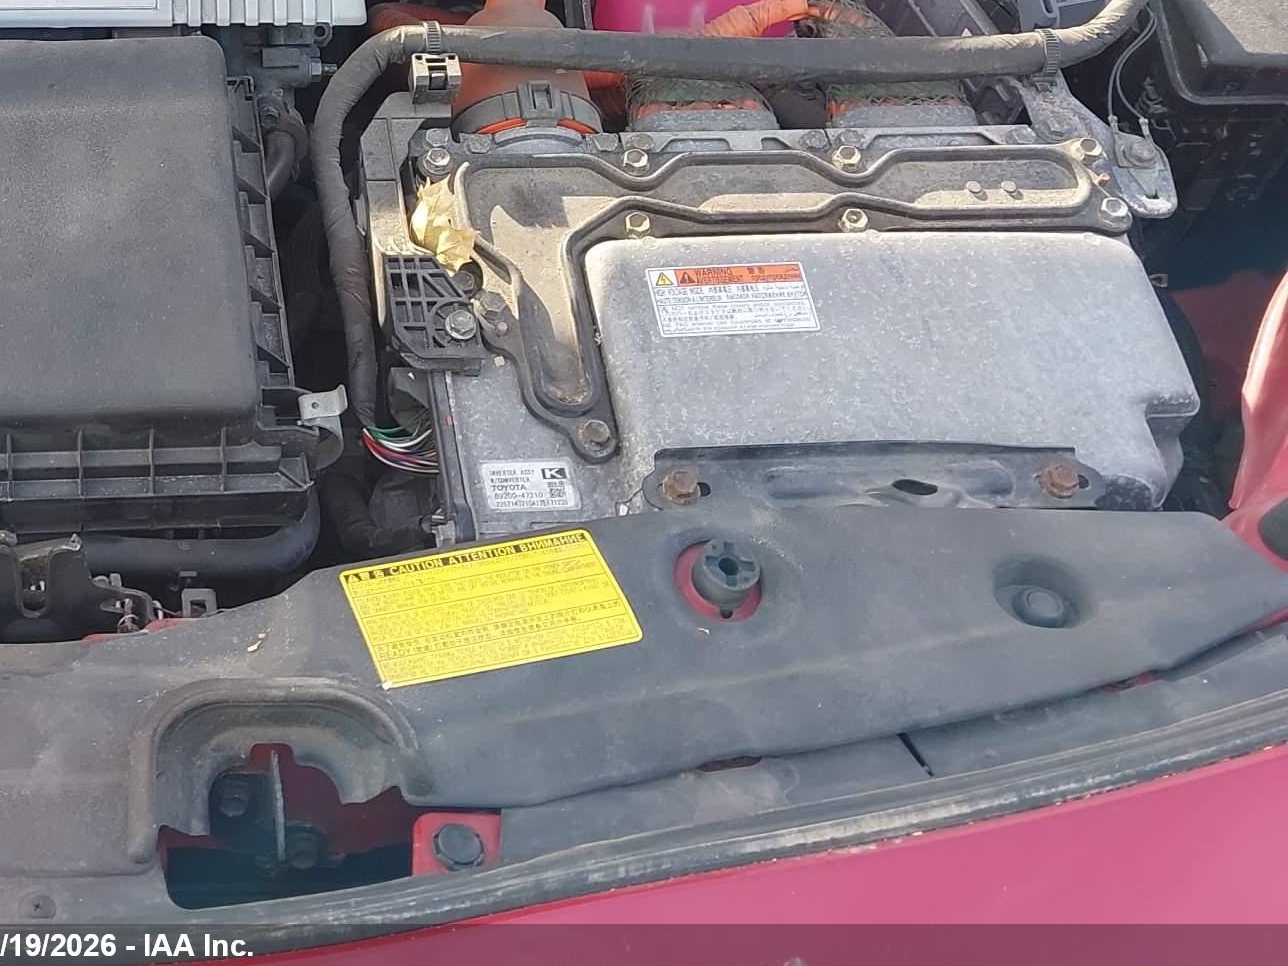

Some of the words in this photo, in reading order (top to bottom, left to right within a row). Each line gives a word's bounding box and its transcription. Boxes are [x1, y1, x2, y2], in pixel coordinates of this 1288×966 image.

[694, 268, 732, 276] WARNING
[696, 275, 744, 283] AVERTISSEMENT
[388, 558, 444, 575] CAUTION
[447, 545, 517, 564] ATTENTION
